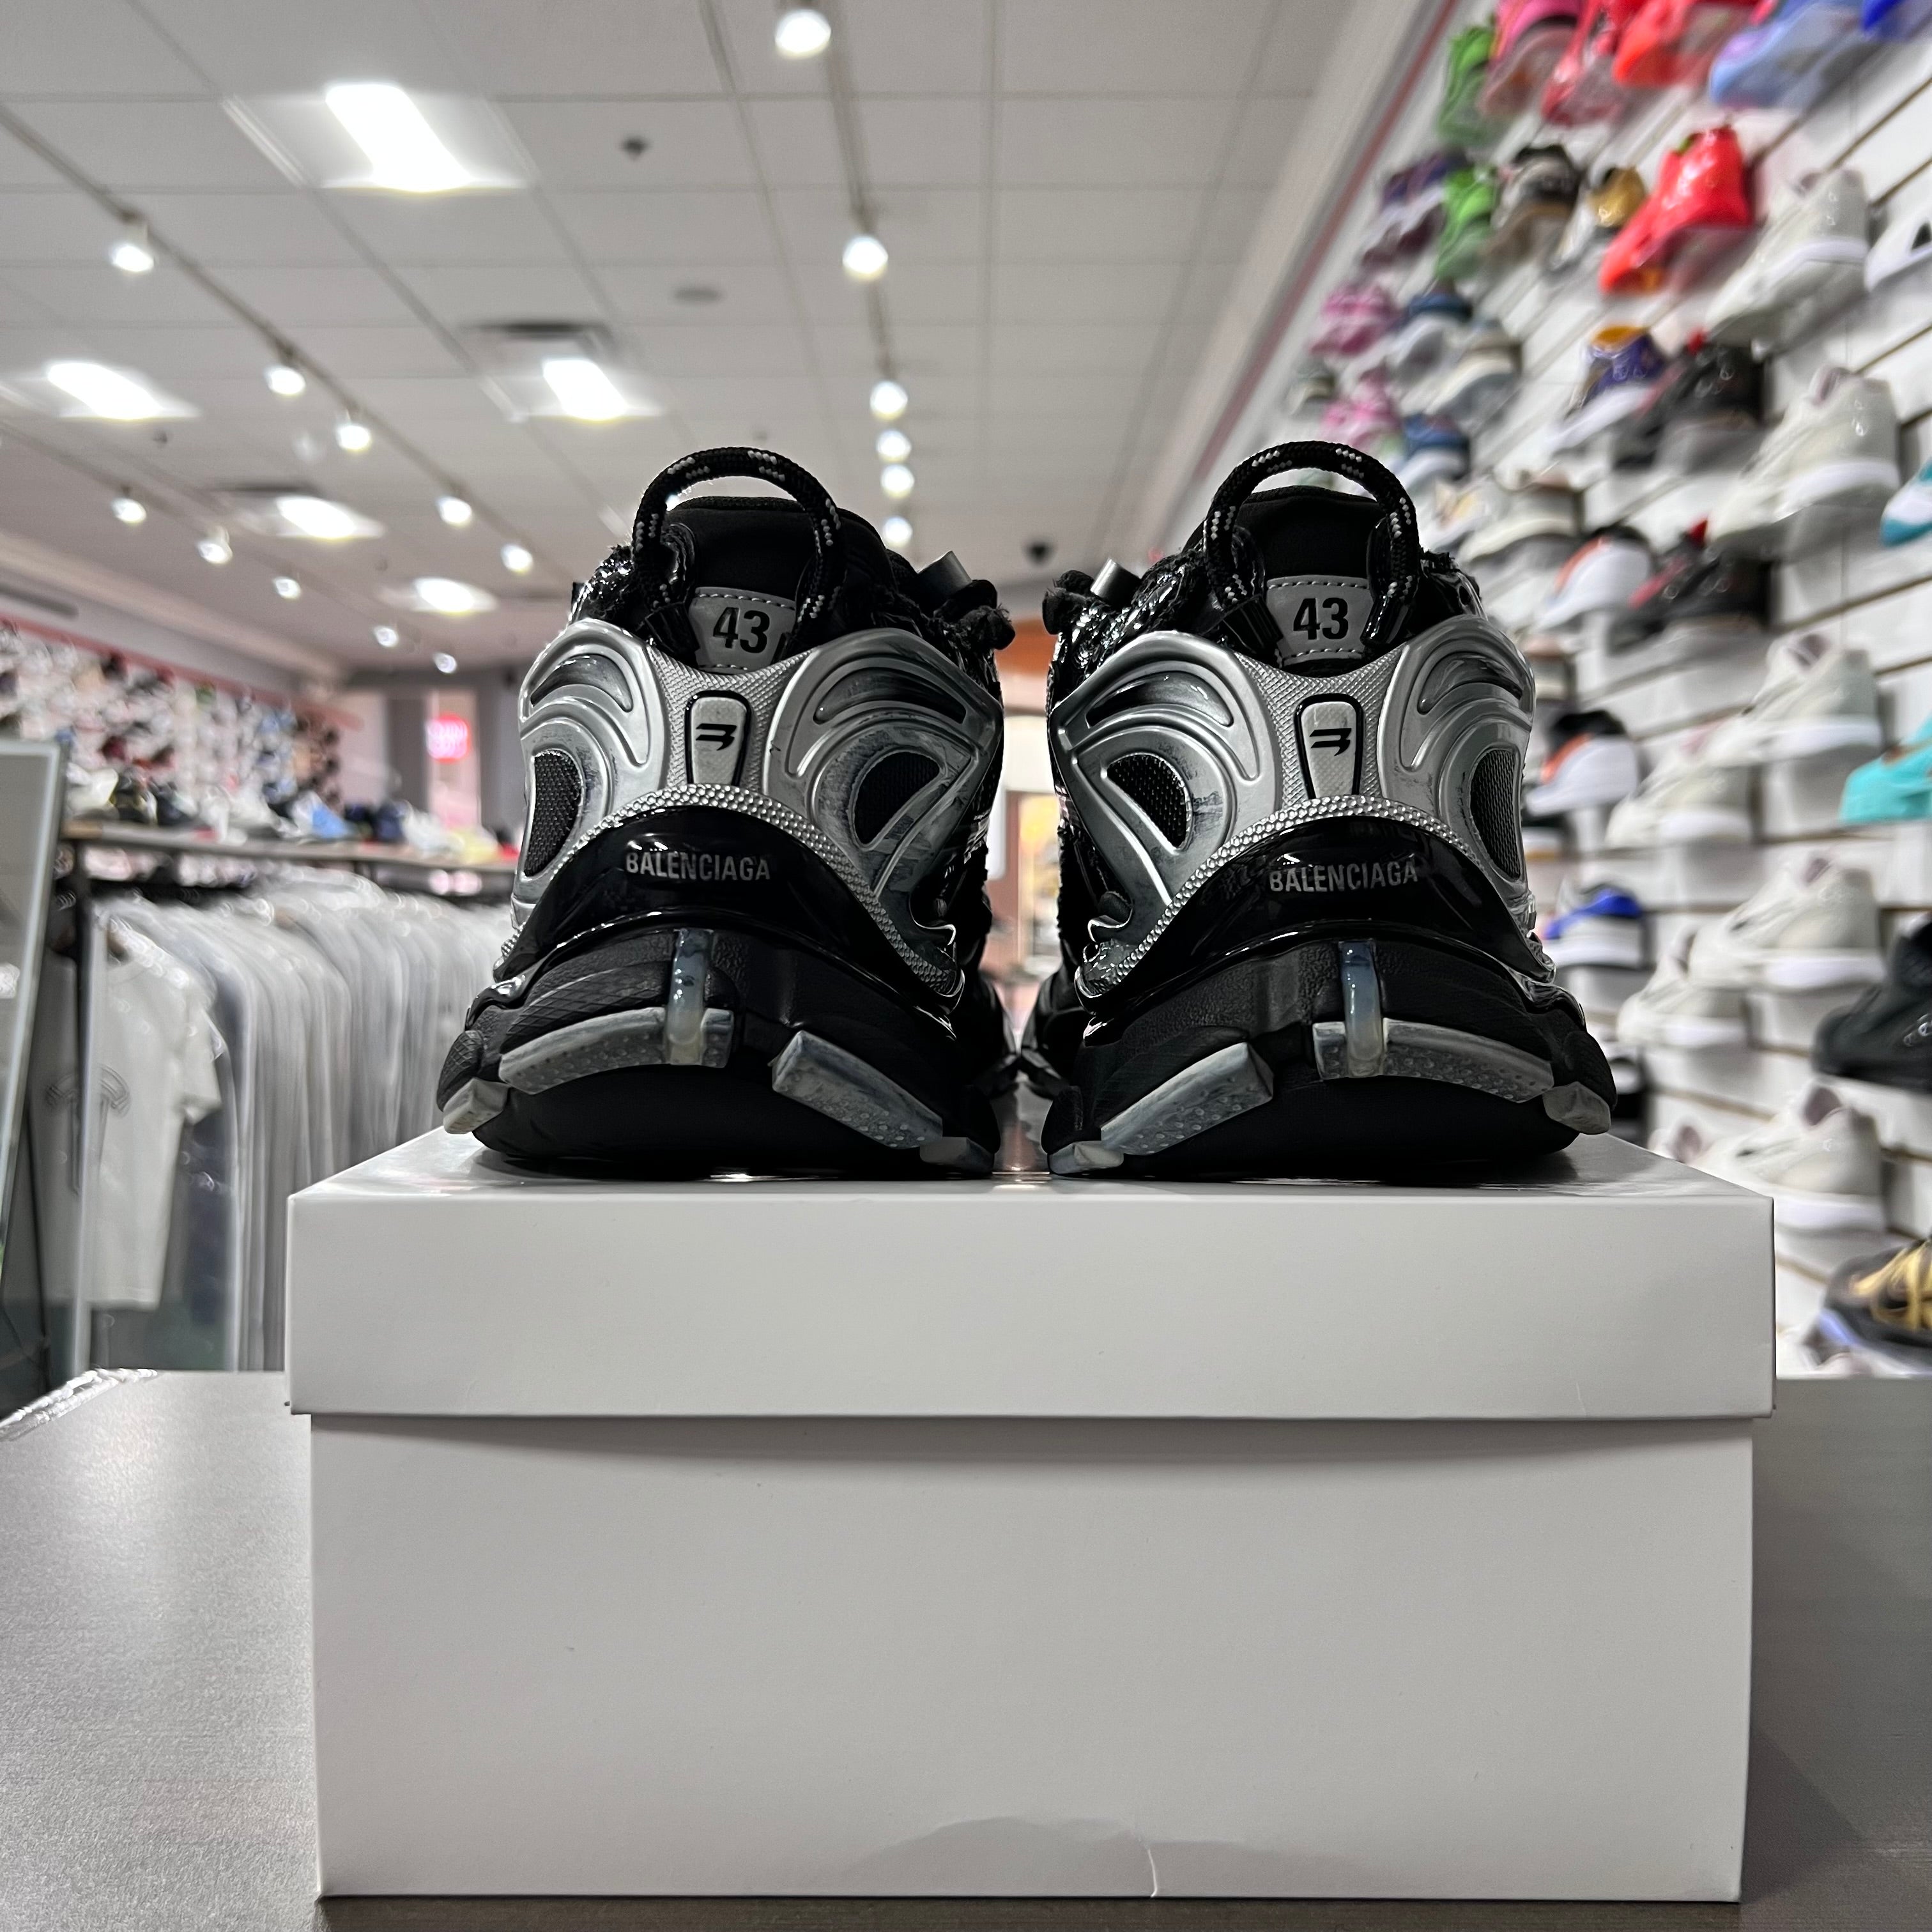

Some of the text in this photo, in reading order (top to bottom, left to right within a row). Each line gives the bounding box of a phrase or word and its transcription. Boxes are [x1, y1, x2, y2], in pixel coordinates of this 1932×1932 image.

[712, 607, 770, 653] 43
[1293, 597, 1349, 640] 43
[625, 851, 770, 881] BALENCIAGA
[1269, 858, 1418, 892] BALENCIAGA
